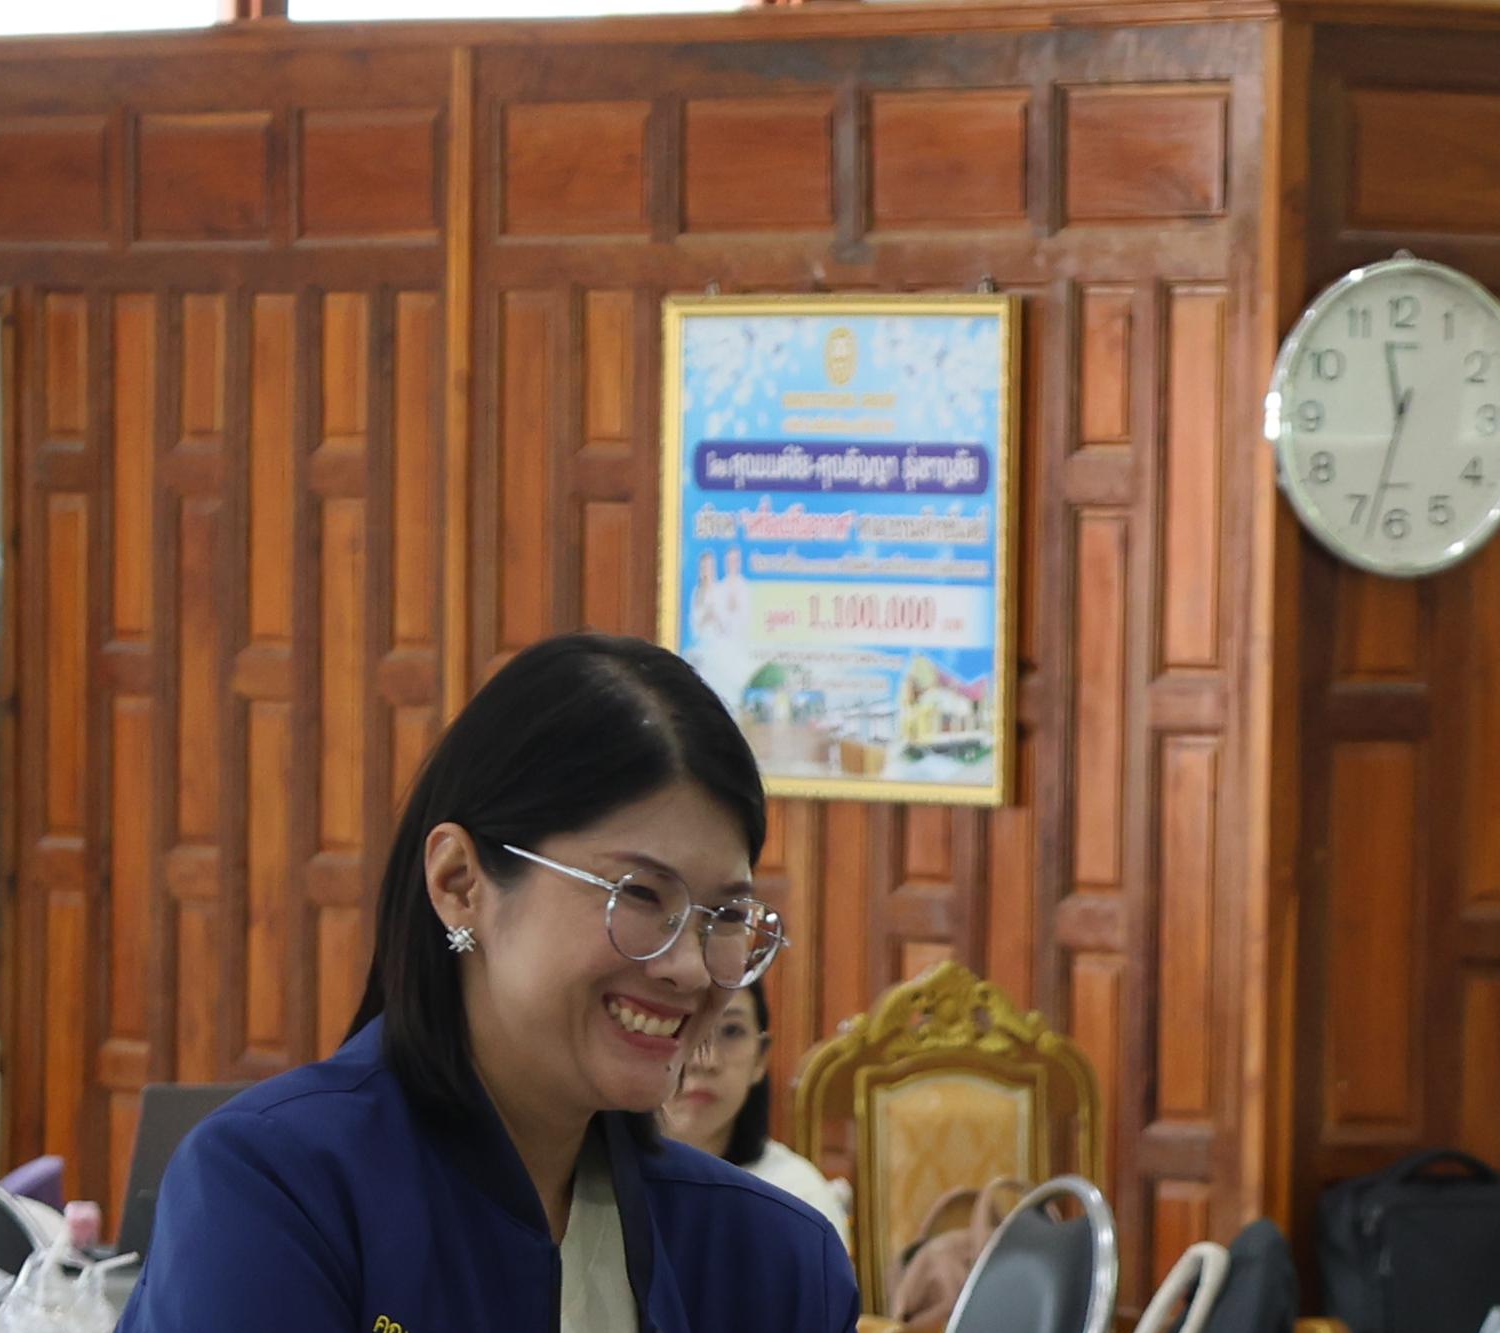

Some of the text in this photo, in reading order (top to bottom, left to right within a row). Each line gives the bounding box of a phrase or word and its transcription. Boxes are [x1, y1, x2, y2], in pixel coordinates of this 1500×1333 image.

[1347, 308, 1372, 338] 11
[1389, 295, 1421, 329] 12
[1443, 311, 1455, 341] 1
[1310, 348, 1346, 381] 10
[1464, 351, 1491, 384] 2
[1299, 400, 1326, 432] 9
[1476, 403, 1498, 436] 3
[1308, 451, 1335, 485] 8
[1459, 456, 1483, 486] 4
[1345, 494, 1369, 525] 7
[1382, 508, 1410, 539] 6
[1428, 495, 1454, 525] 5
